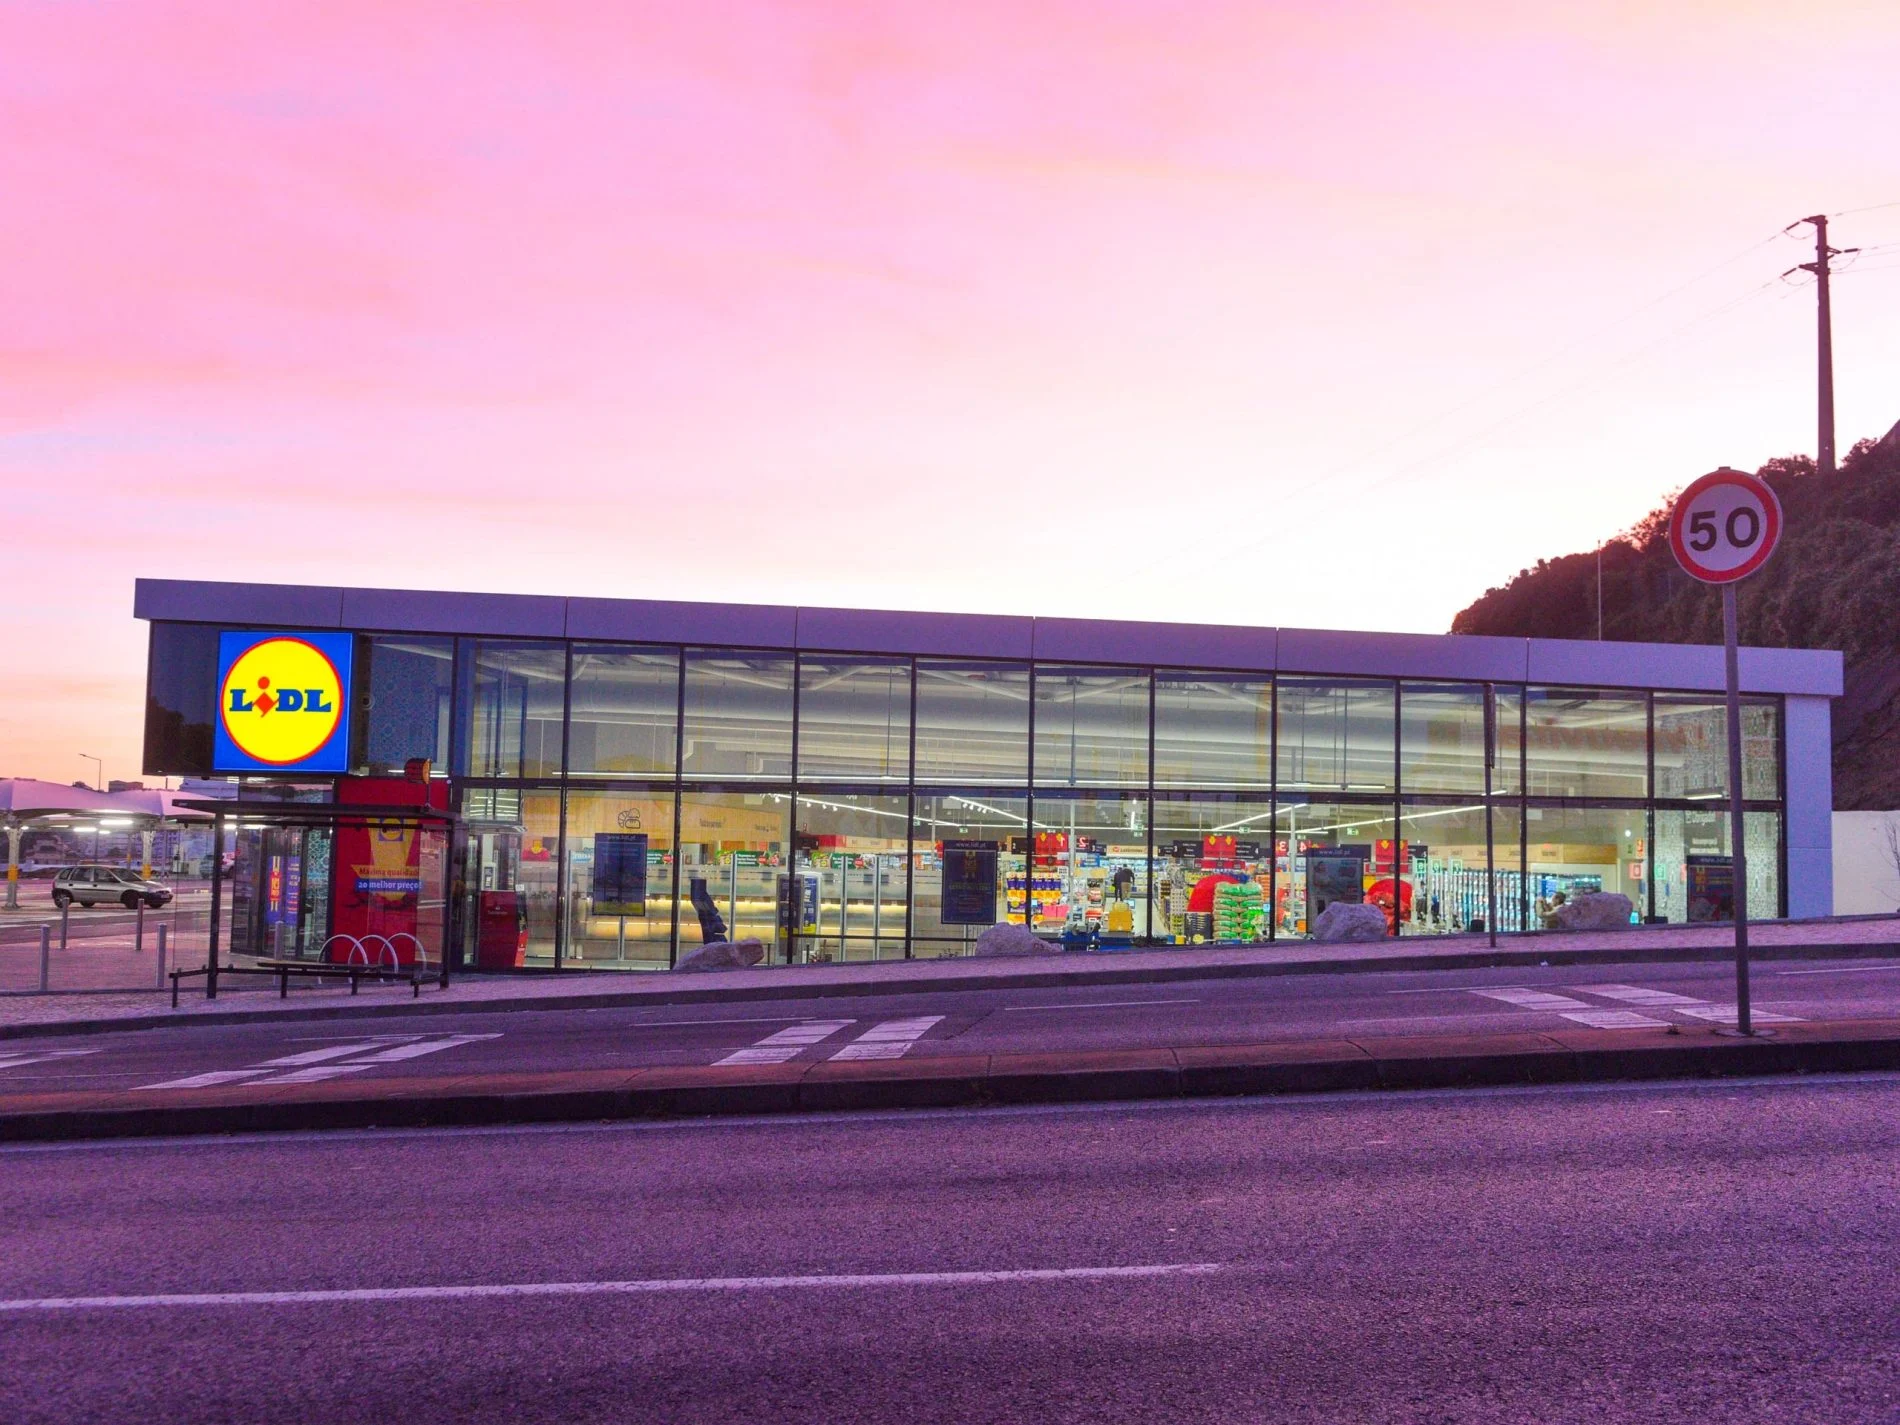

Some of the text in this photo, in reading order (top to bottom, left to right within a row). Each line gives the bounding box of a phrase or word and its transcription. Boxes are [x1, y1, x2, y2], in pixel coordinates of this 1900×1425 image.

[1689, 506, 1760, 551] 50
[358, 881, 368, 889] ao
[369, 880, 396, 889] melhor
